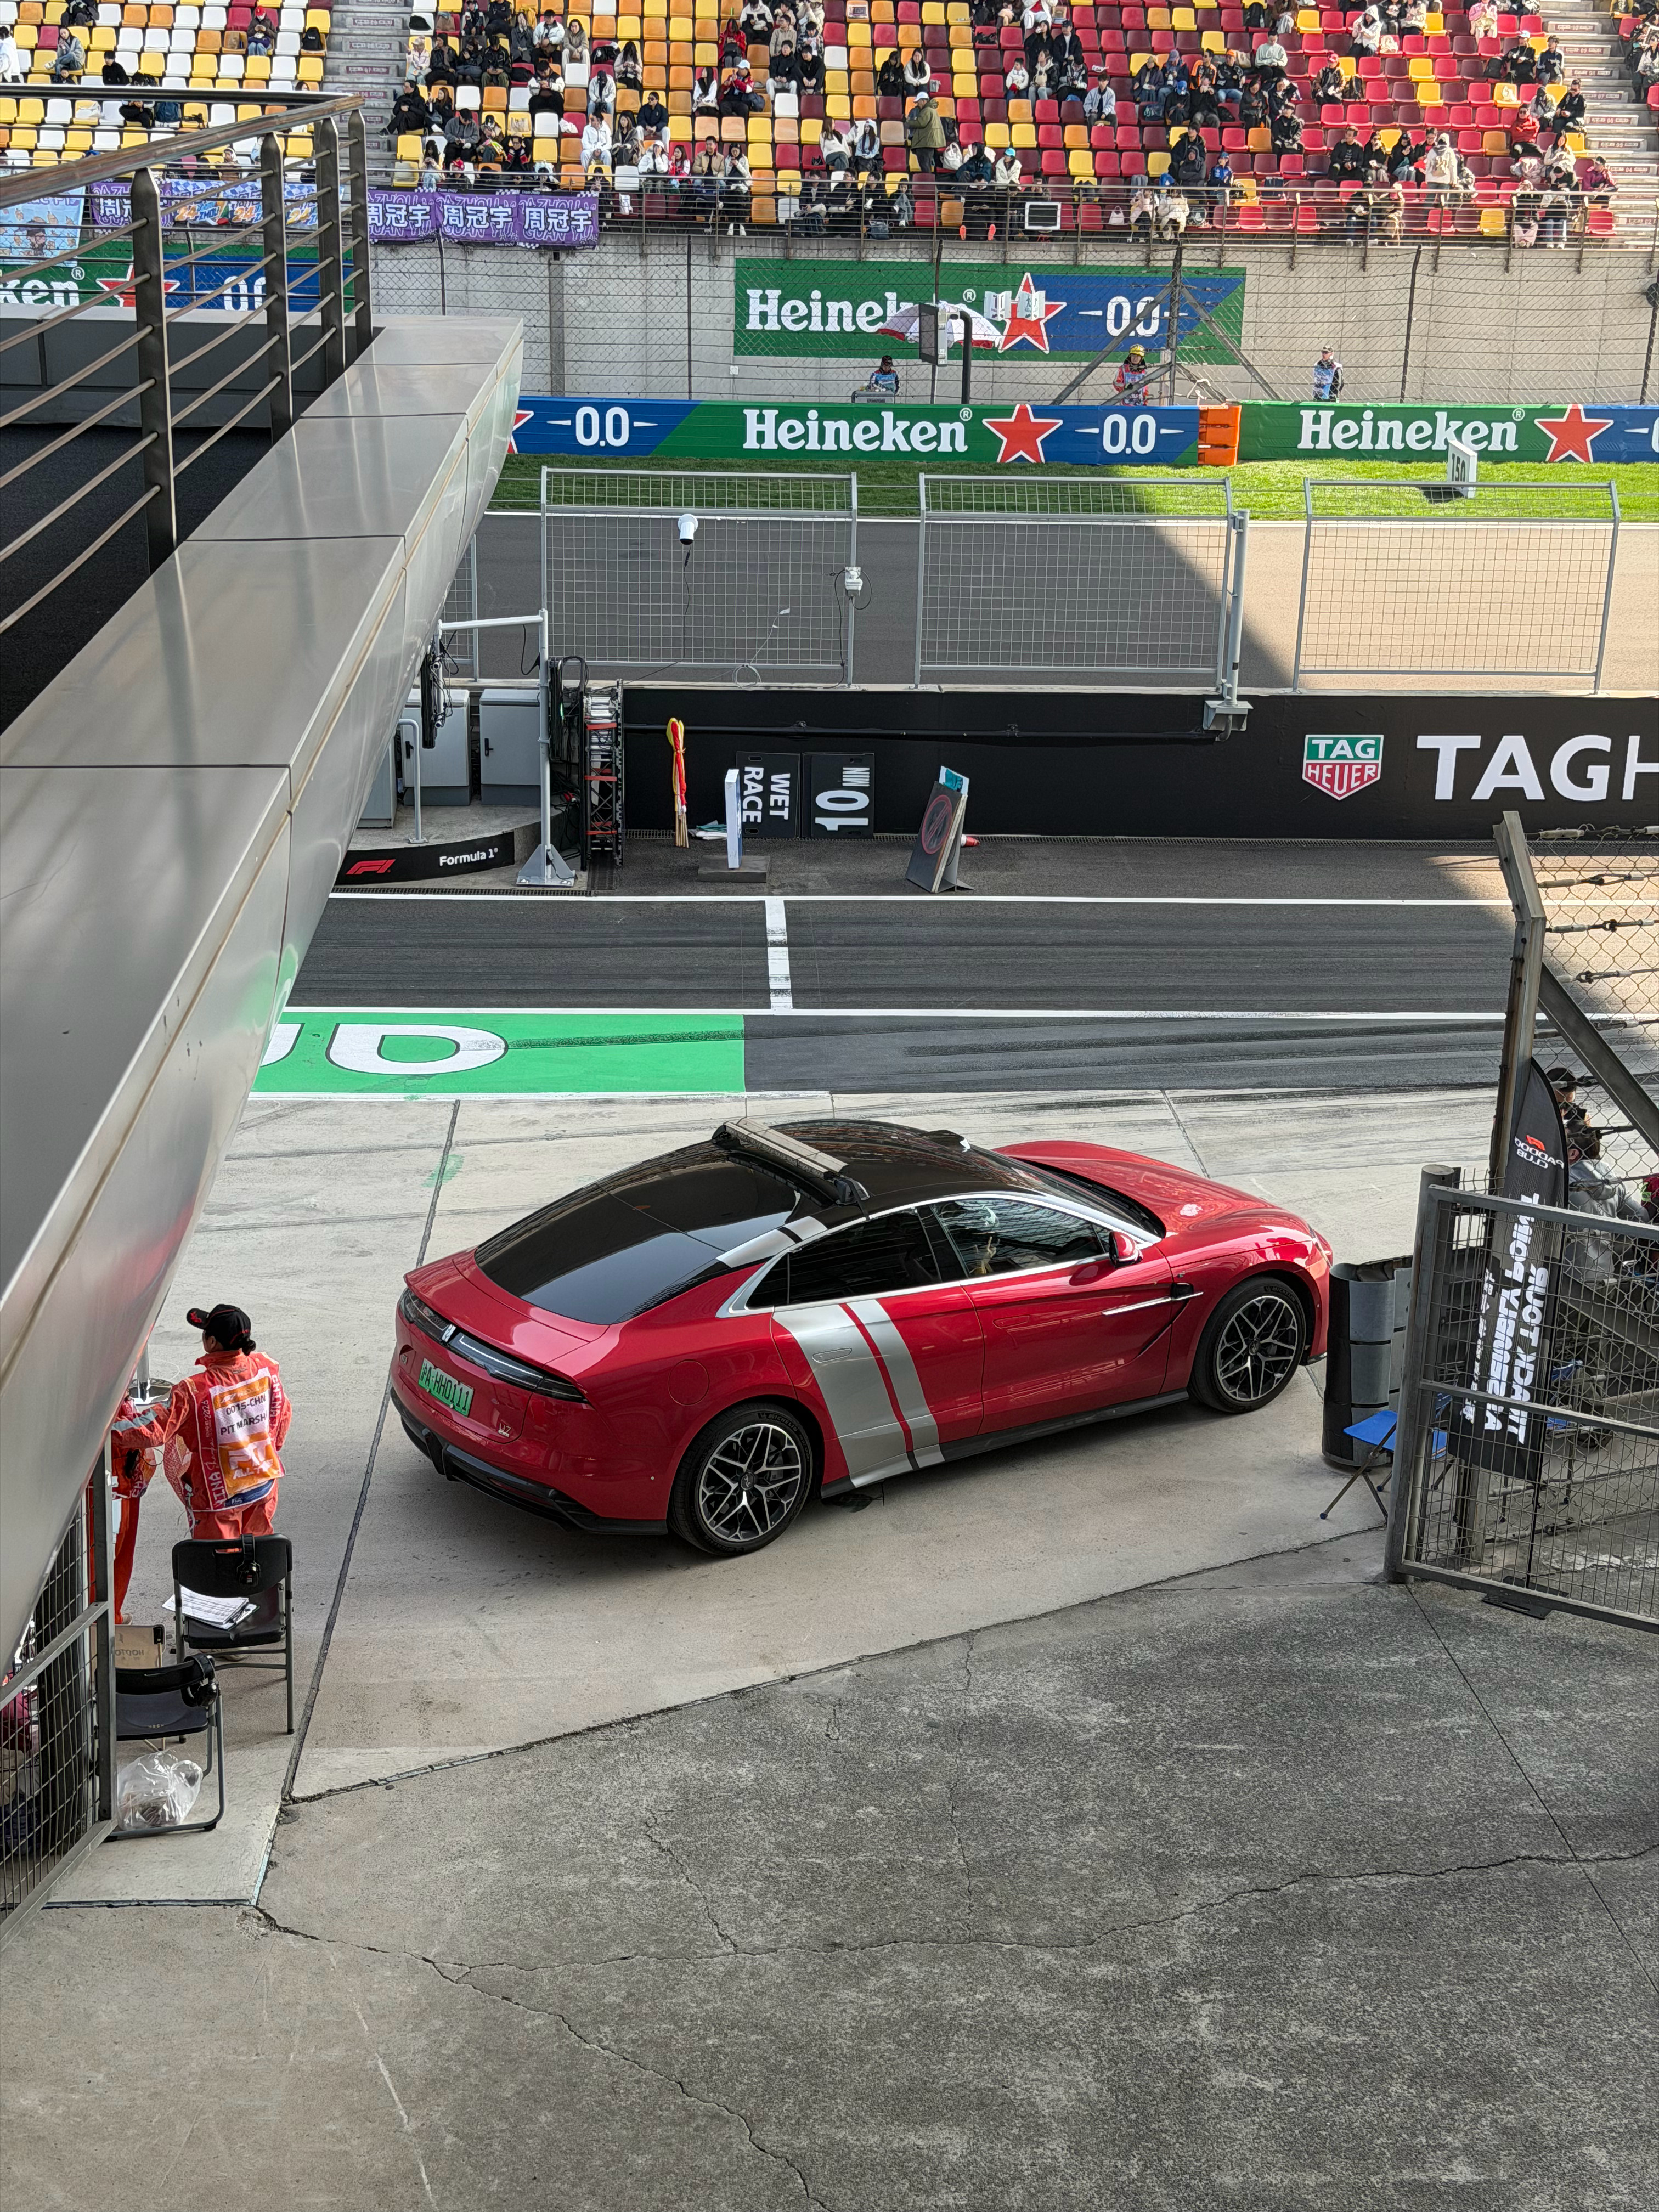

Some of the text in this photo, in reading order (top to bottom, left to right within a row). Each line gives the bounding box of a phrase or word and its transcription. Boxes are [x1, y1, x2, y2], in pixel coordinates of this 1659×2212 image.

[368, 202, 431, 228] 周冠宇
[443, 204, 513, 229] 周冠宇
[524, 207, 592, 233] 周冠宇
[575, 406, 629, 447] 0.0
[742, 409, 1156, 454] Heineken 0.0
[1297, 410, 1519, 452] Heineken
[1312, 739, 1376, 759] TAG
[1307, 764, 1376, 795] HEUER
[742, 766, 764, 823] RACE
[769, 772, 791, 820] WET
[815, 767, 870, 831] 10 MIN
[439, 850, 487, 866] Formula
[225, 1394, 266, 1415] 0015-CHN
[270, 1374, 283, 1417] CHINA
[221, 1423, 235, 1436] PIT
[499, 1423, 511, 1433] U7
[768, 1414, 799, 1432] MICHELIN
